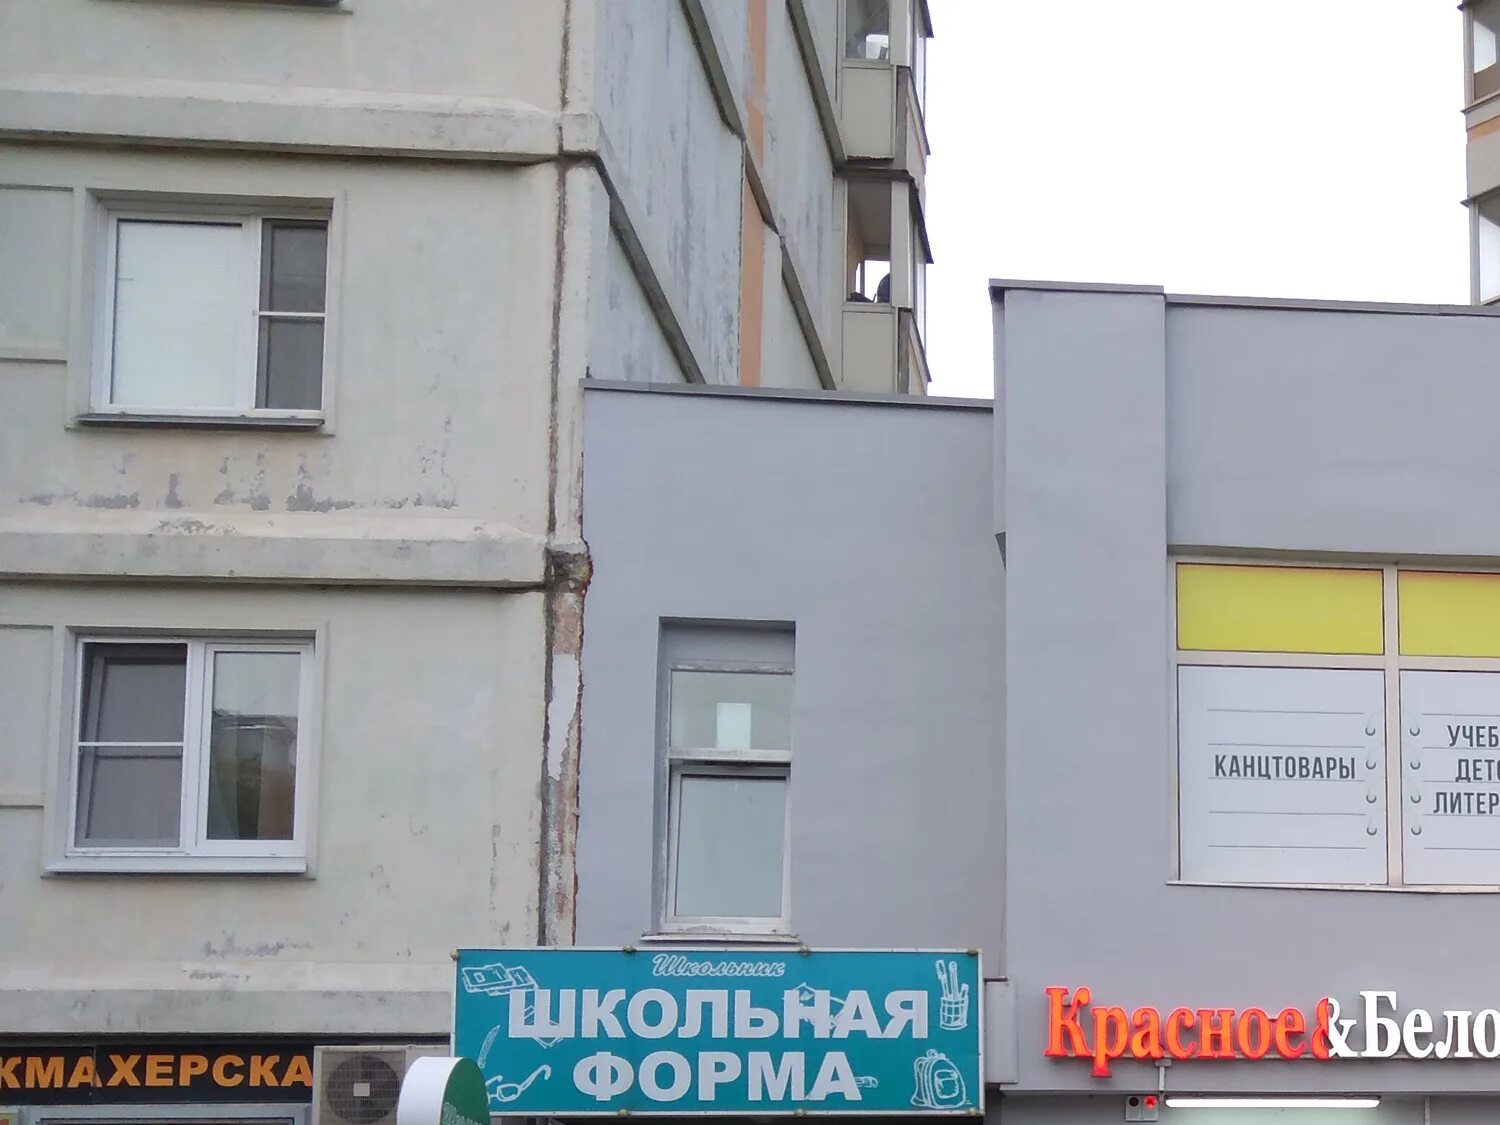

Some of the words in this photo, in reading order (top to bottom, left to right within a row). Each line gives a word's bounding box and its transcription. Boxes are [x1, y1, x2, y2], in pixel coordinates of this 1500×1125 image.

[1214, 754, 1356, 782] КАНЦТОВАРЫ
[652, 954, 786, 977] Школьник
[508, 988, 929, 1039] ШКОЛЬНАЯ
[572, 1050, 863, 1102] ФОРМА
